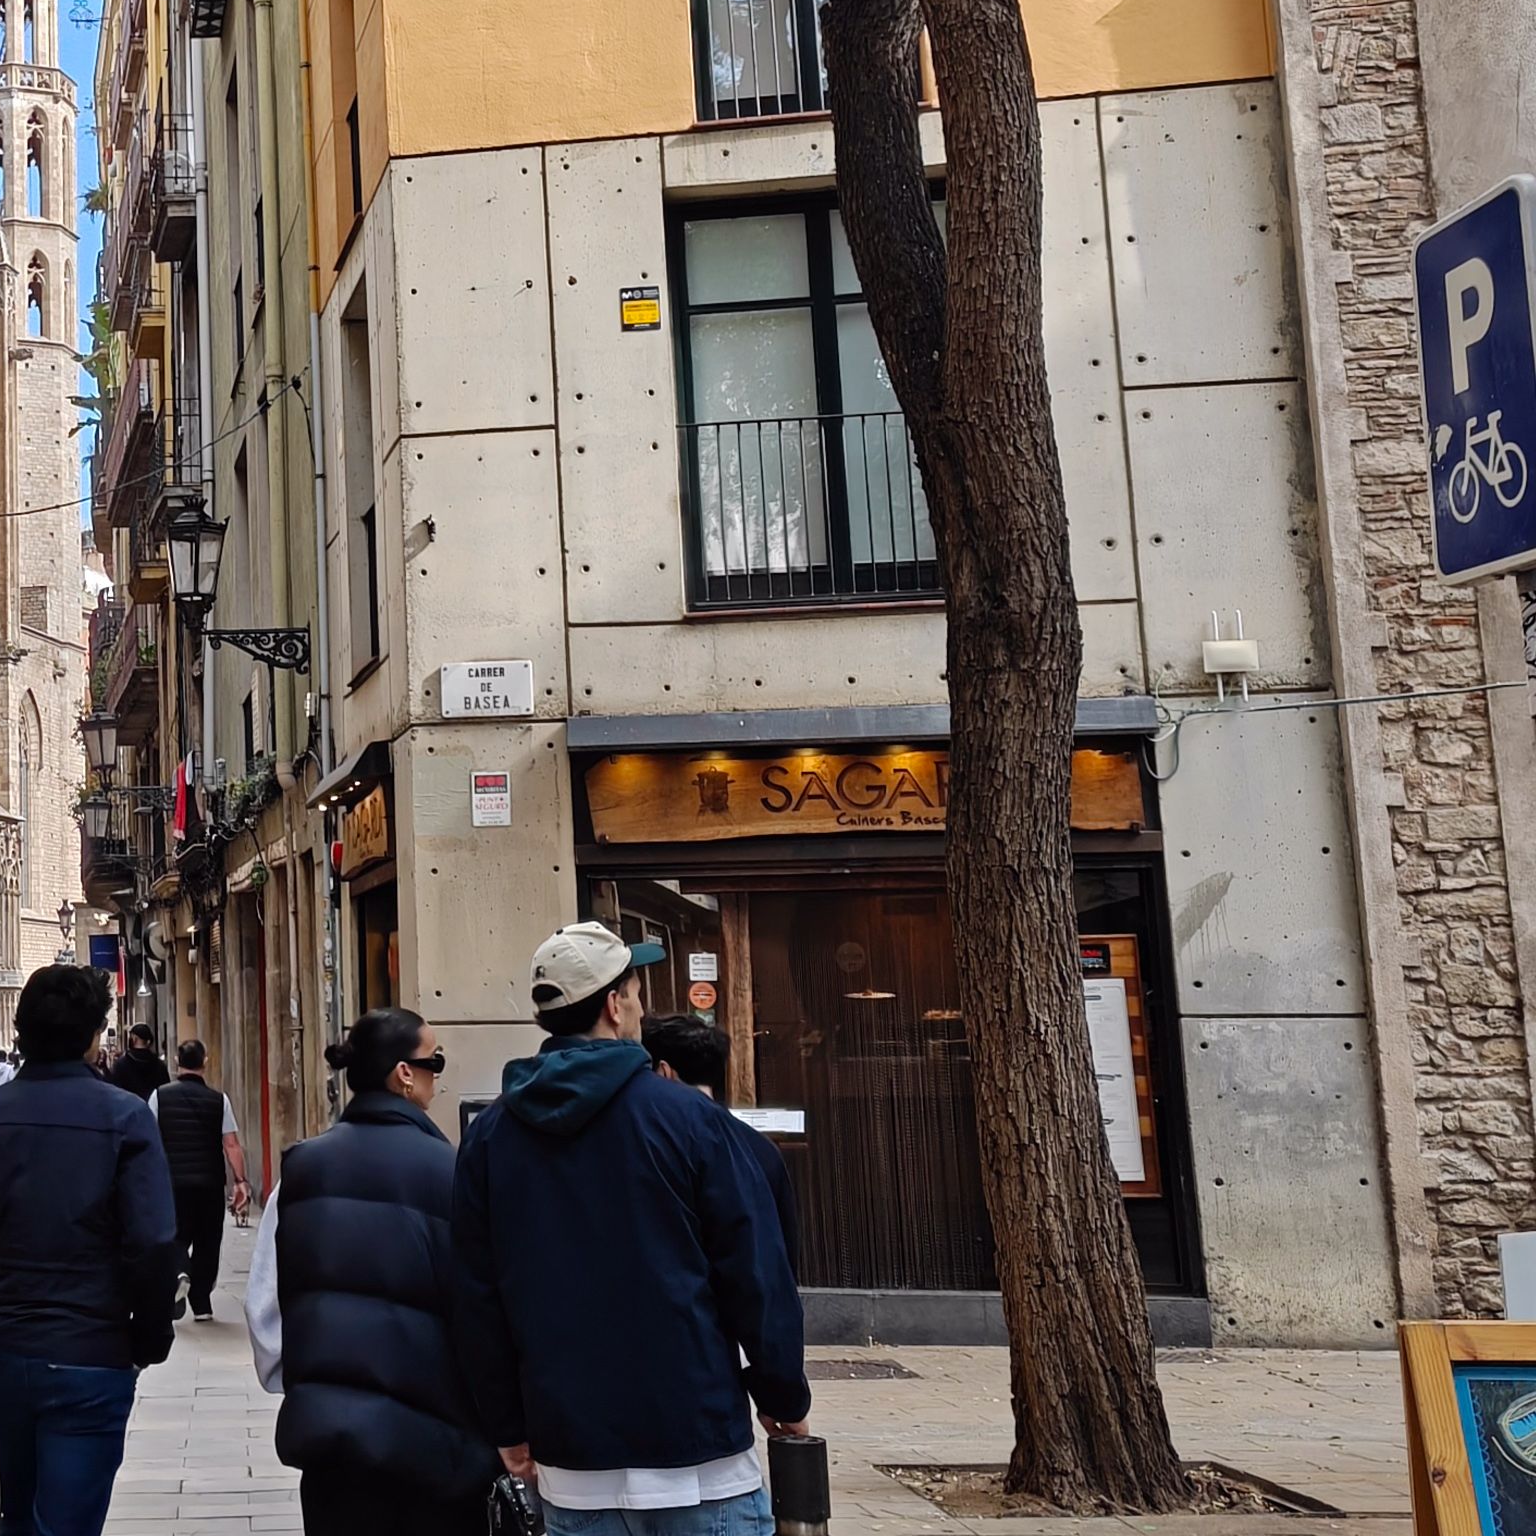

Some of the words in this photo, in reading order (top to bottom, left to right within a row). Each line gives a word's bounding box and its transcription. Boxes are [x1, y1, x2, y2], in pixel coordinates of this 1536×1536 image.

[1445, 257, 1495, 395] P
[468, 667, 505, 678] CARRER
[480, 682, 493, 693] DE
[464, 695, 511, 710] BASEA
